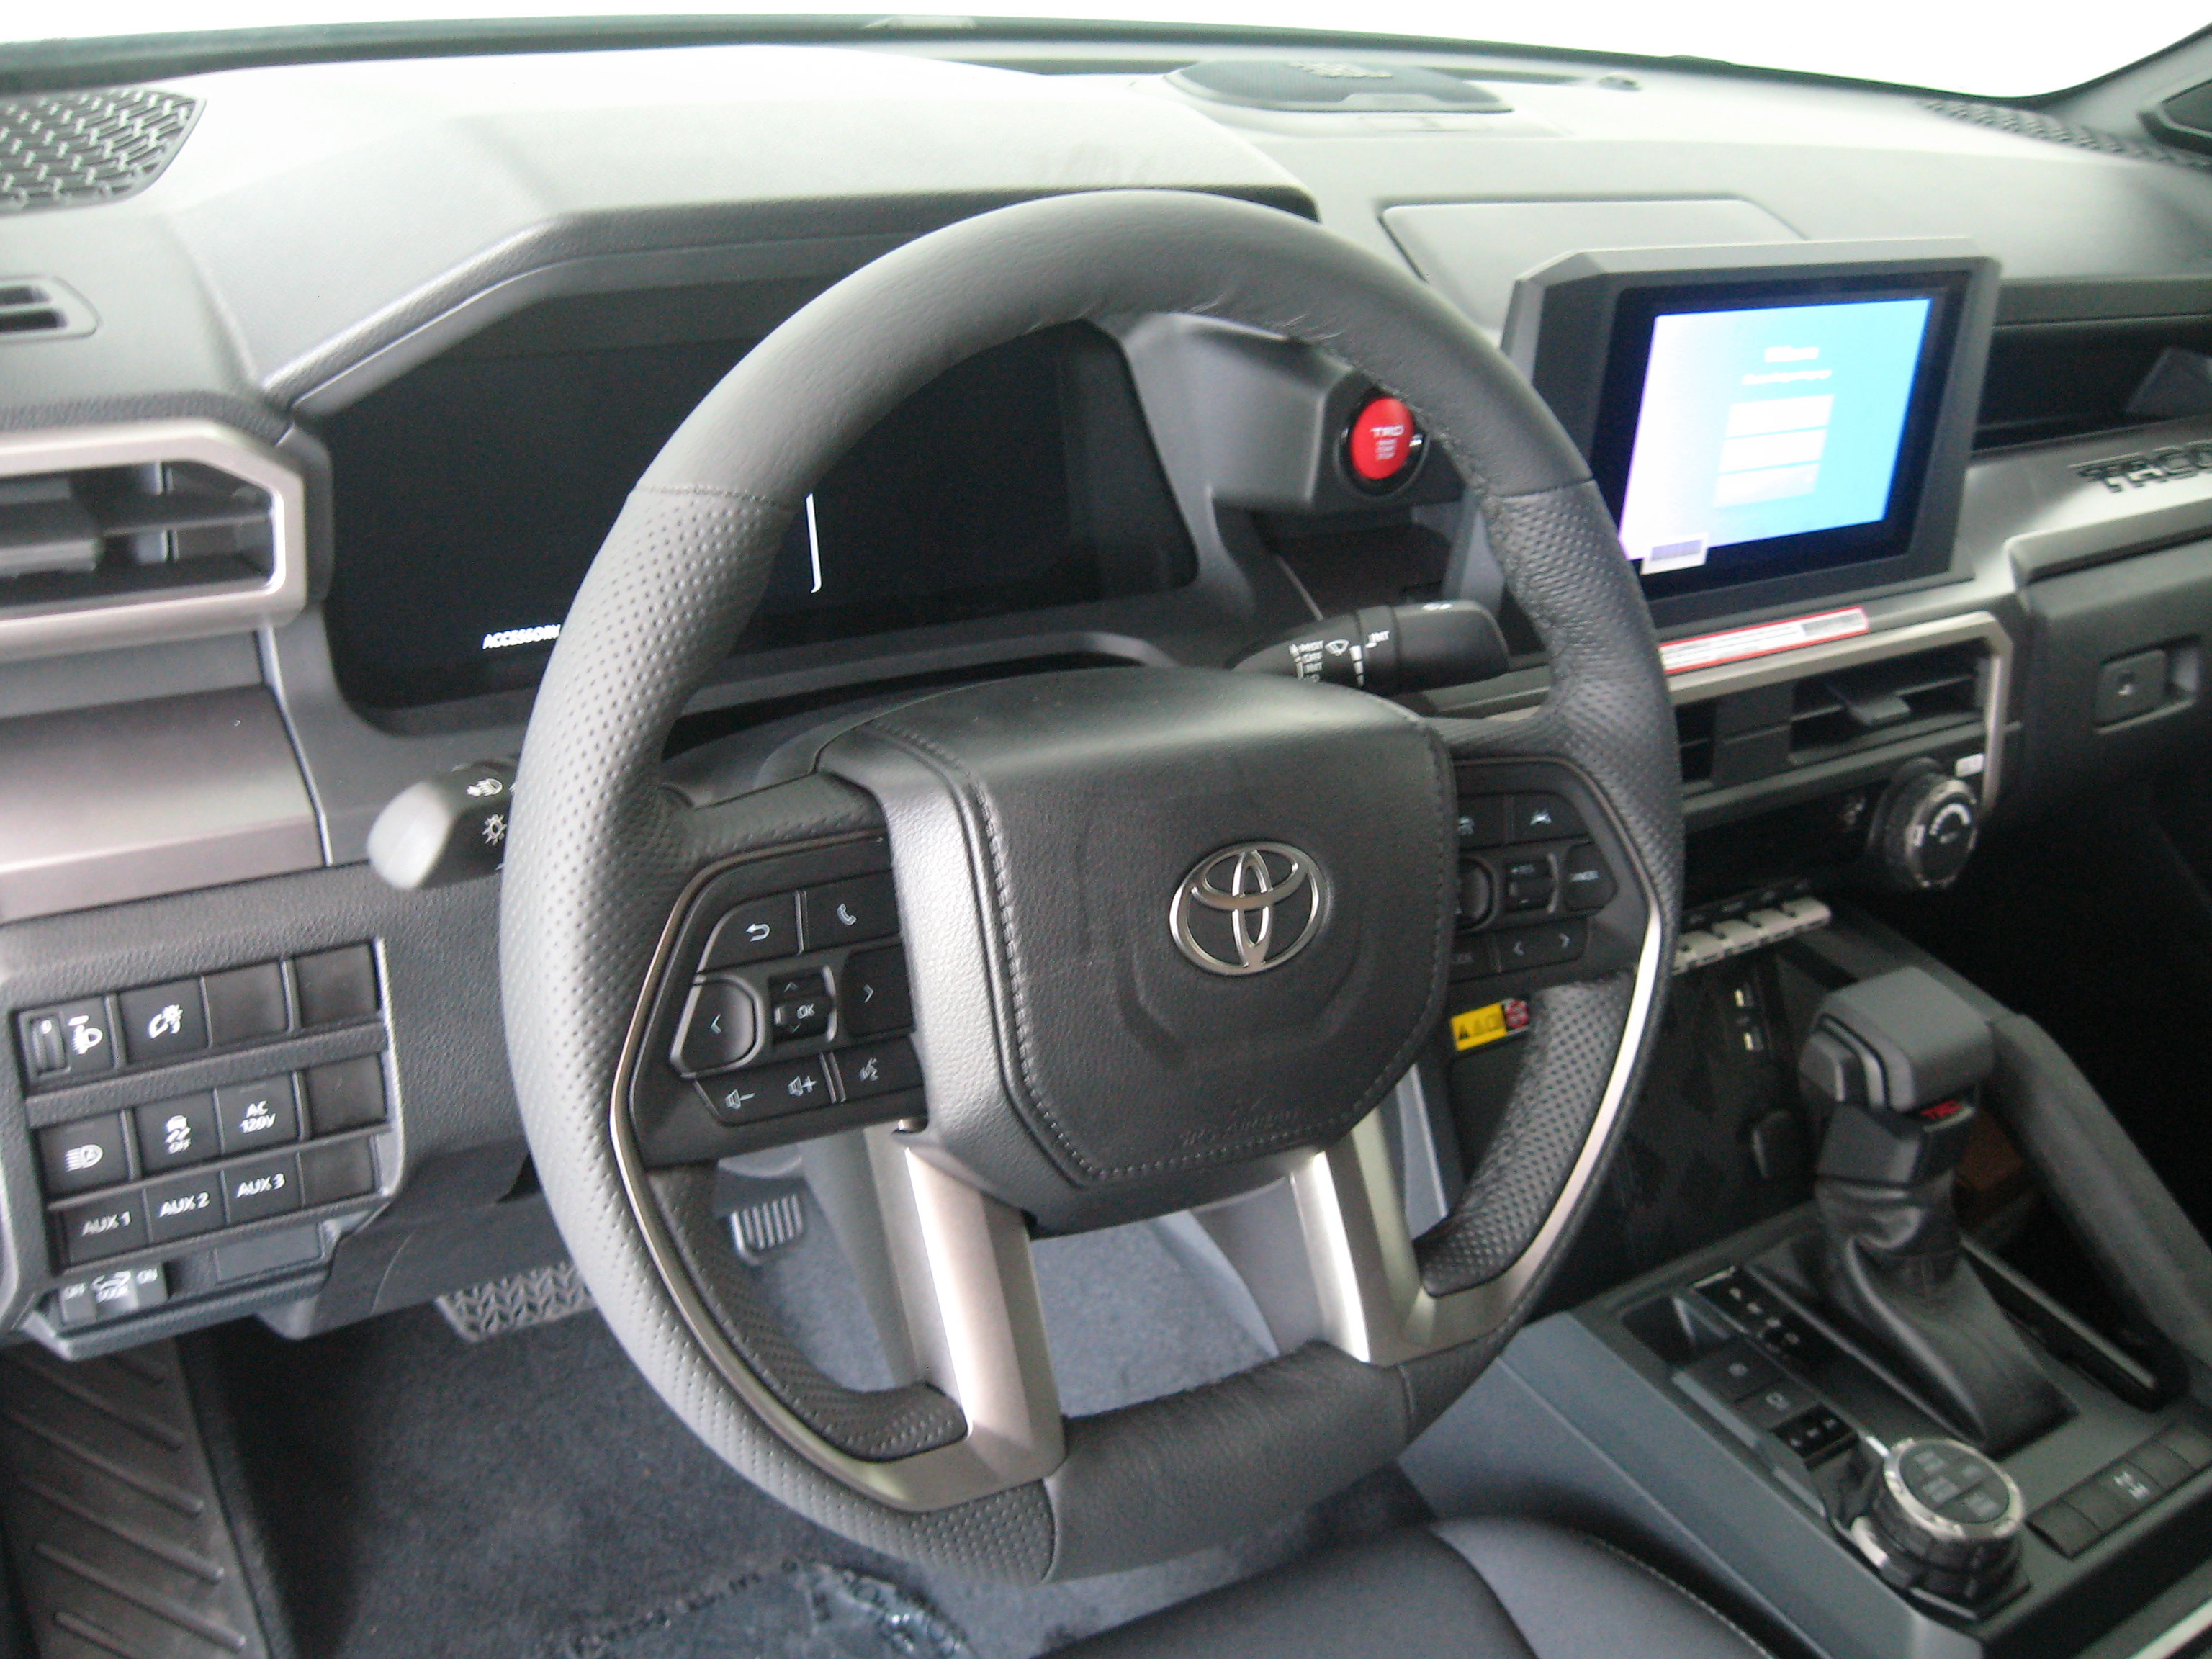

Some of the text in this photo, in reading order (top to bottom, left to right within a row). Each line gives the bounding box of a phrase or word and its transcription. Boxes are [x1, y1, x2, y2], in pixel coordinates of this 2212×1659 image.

[1370, 424, 1405, 439] TRD
[482, 624, 561, 650] ACCESSORY
[797, 1003, 816, 1020] OK
[246, 1100, 269, 1118] AC
[239, 1113, 276, 1134] 120V
[236, 1173, 286, 1198] AUX 3
[158, 1192, 210, 1218] AUX 2
[81, 1210, 132, 1236] AUX 1
